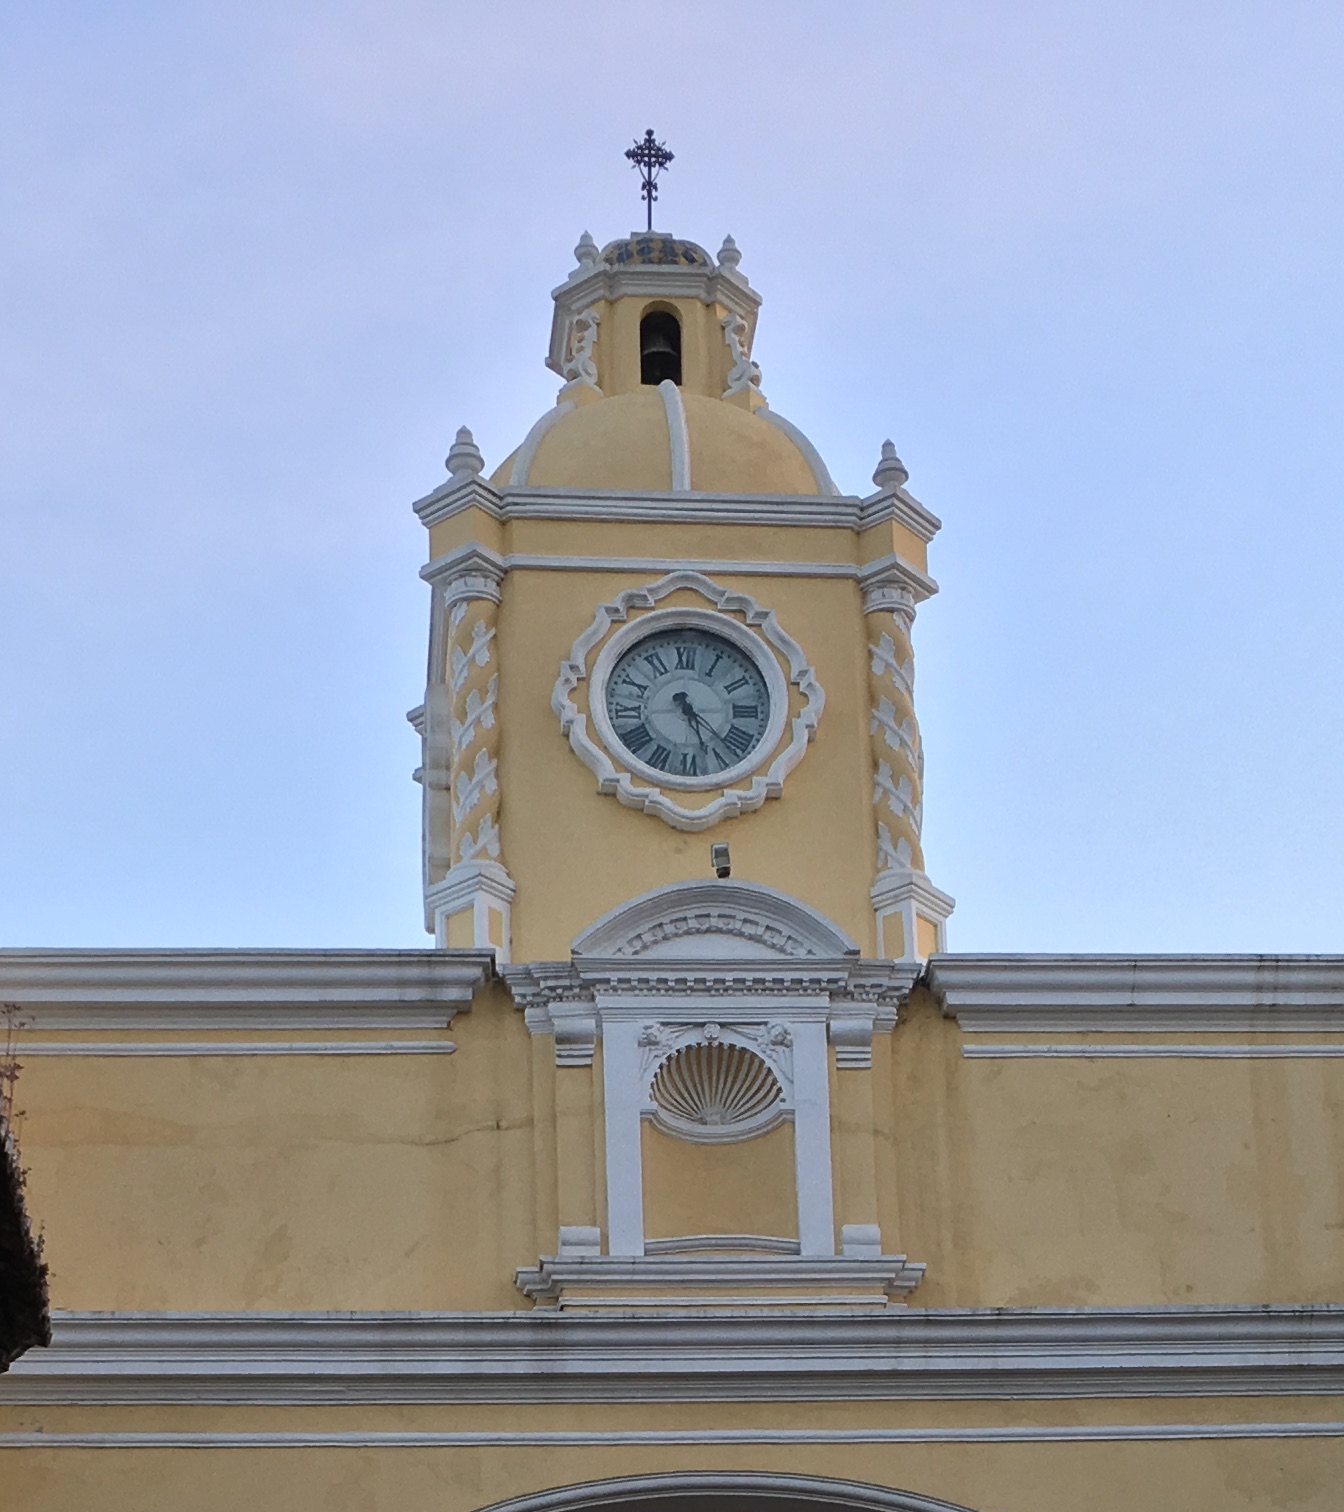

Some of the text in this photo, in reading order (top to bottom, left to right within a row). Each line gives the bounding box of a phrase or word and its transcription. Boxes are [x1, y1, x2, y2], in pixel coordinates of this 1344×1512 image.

[643, 652, 670, 679] XI
[674, 646, 695, 671] XII
[705, 653, 723, 678] I
[622, 673, 649, 699] X
[724, 675, 750, 695] II
[733, 703, 759, 720] III
